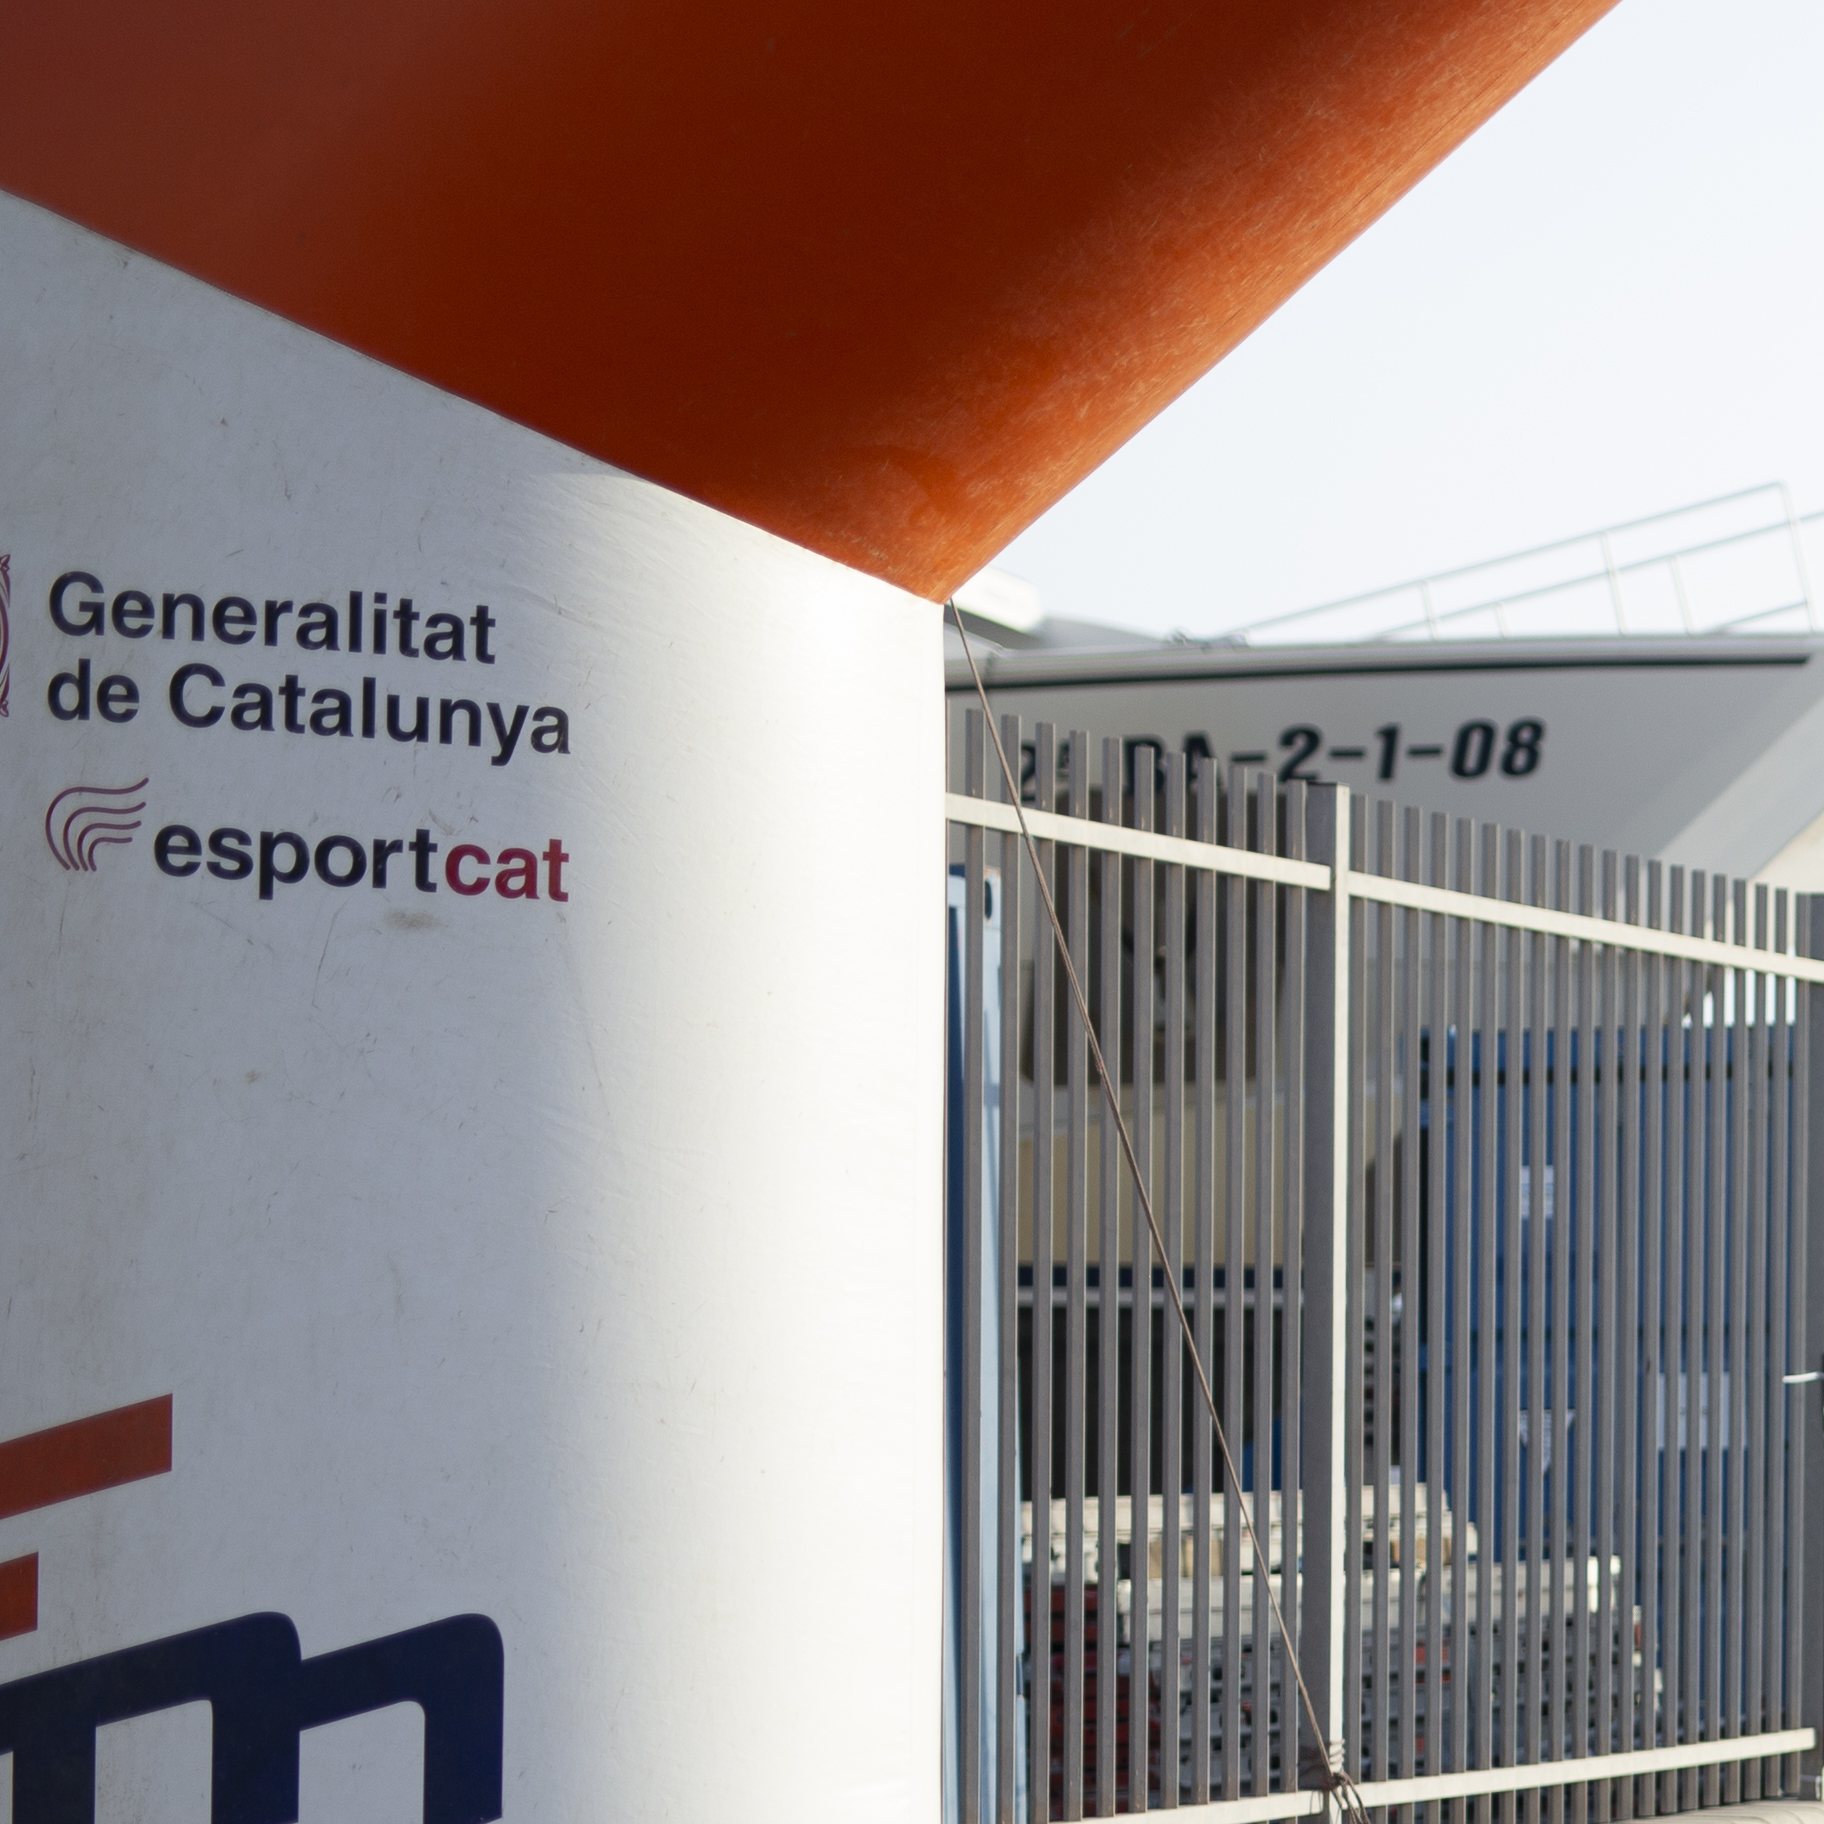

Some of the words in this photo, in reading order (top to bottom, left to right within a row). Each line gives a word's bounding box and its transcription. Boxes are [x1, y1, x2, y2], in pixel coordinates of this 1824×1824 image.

[49, 571, 496, 666] Generalitat
[48, 658, 140, 723] de
[168, 662, 570, 767] Catalunya
[153, 824, 570, 901] esportcat
